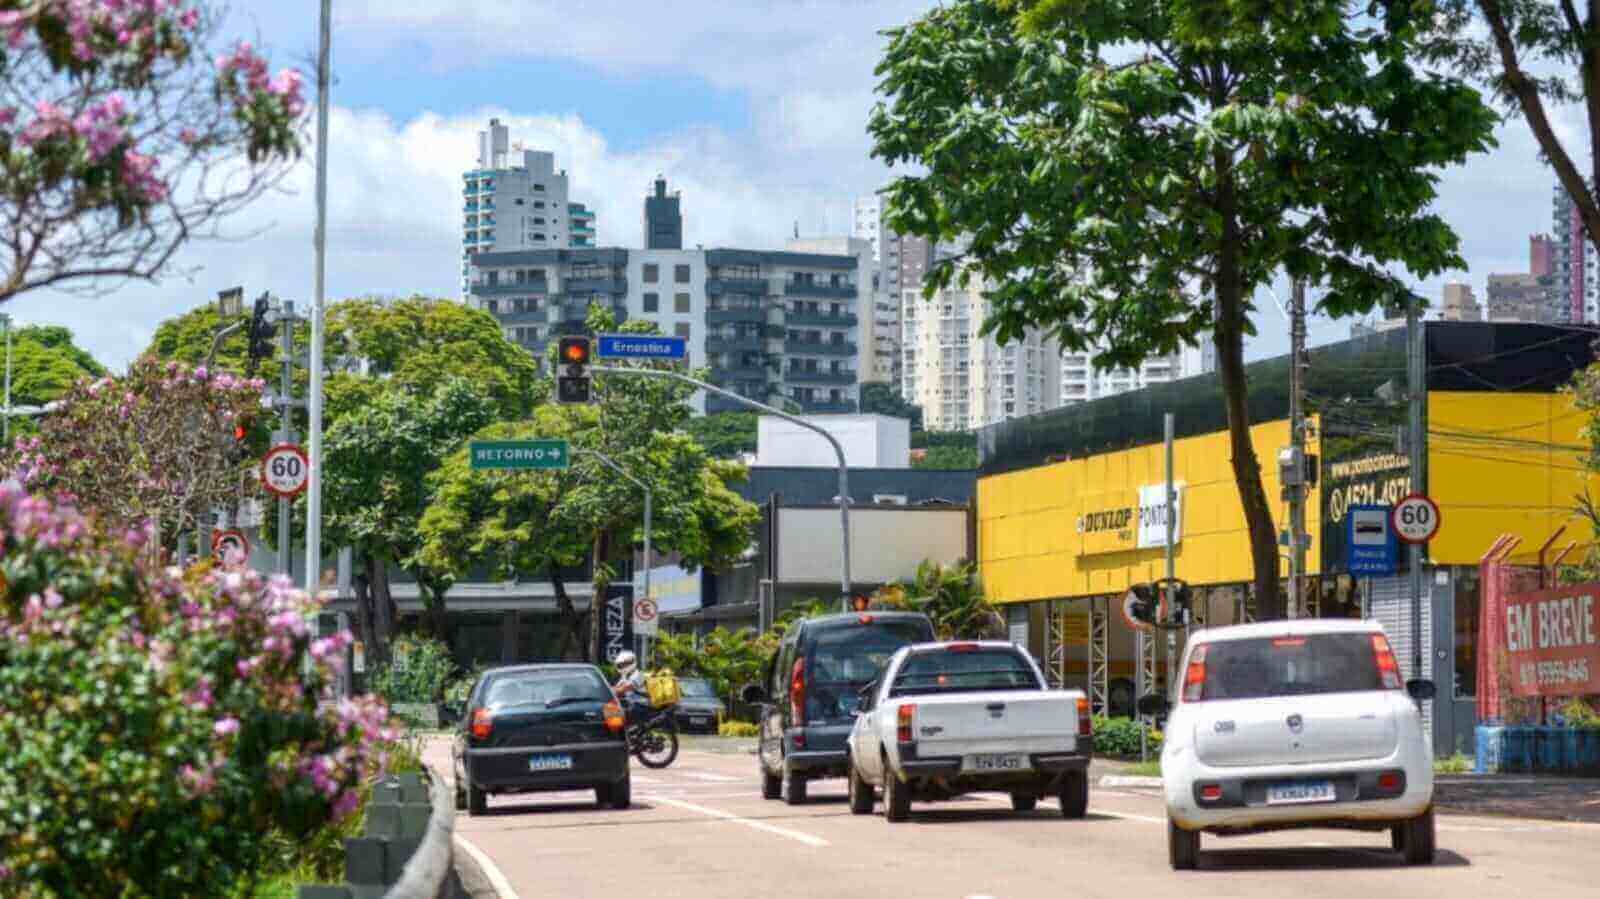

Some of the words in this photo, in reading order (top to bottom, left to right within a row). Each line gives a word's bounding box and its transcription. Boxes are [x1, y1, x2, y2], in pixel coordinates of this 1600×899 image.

[612, 342, 672, 354] Ernestina
[476, 447, 544, 460] RETORNO
[271, 455, 301, 477] 60
[1085, 507, 1132, 533] DUNLOP
[1401, 504, 1430, 525] 60
[1506, 603, 1534, 652] EM
[1538, 595, 1595, 649] BREVE
